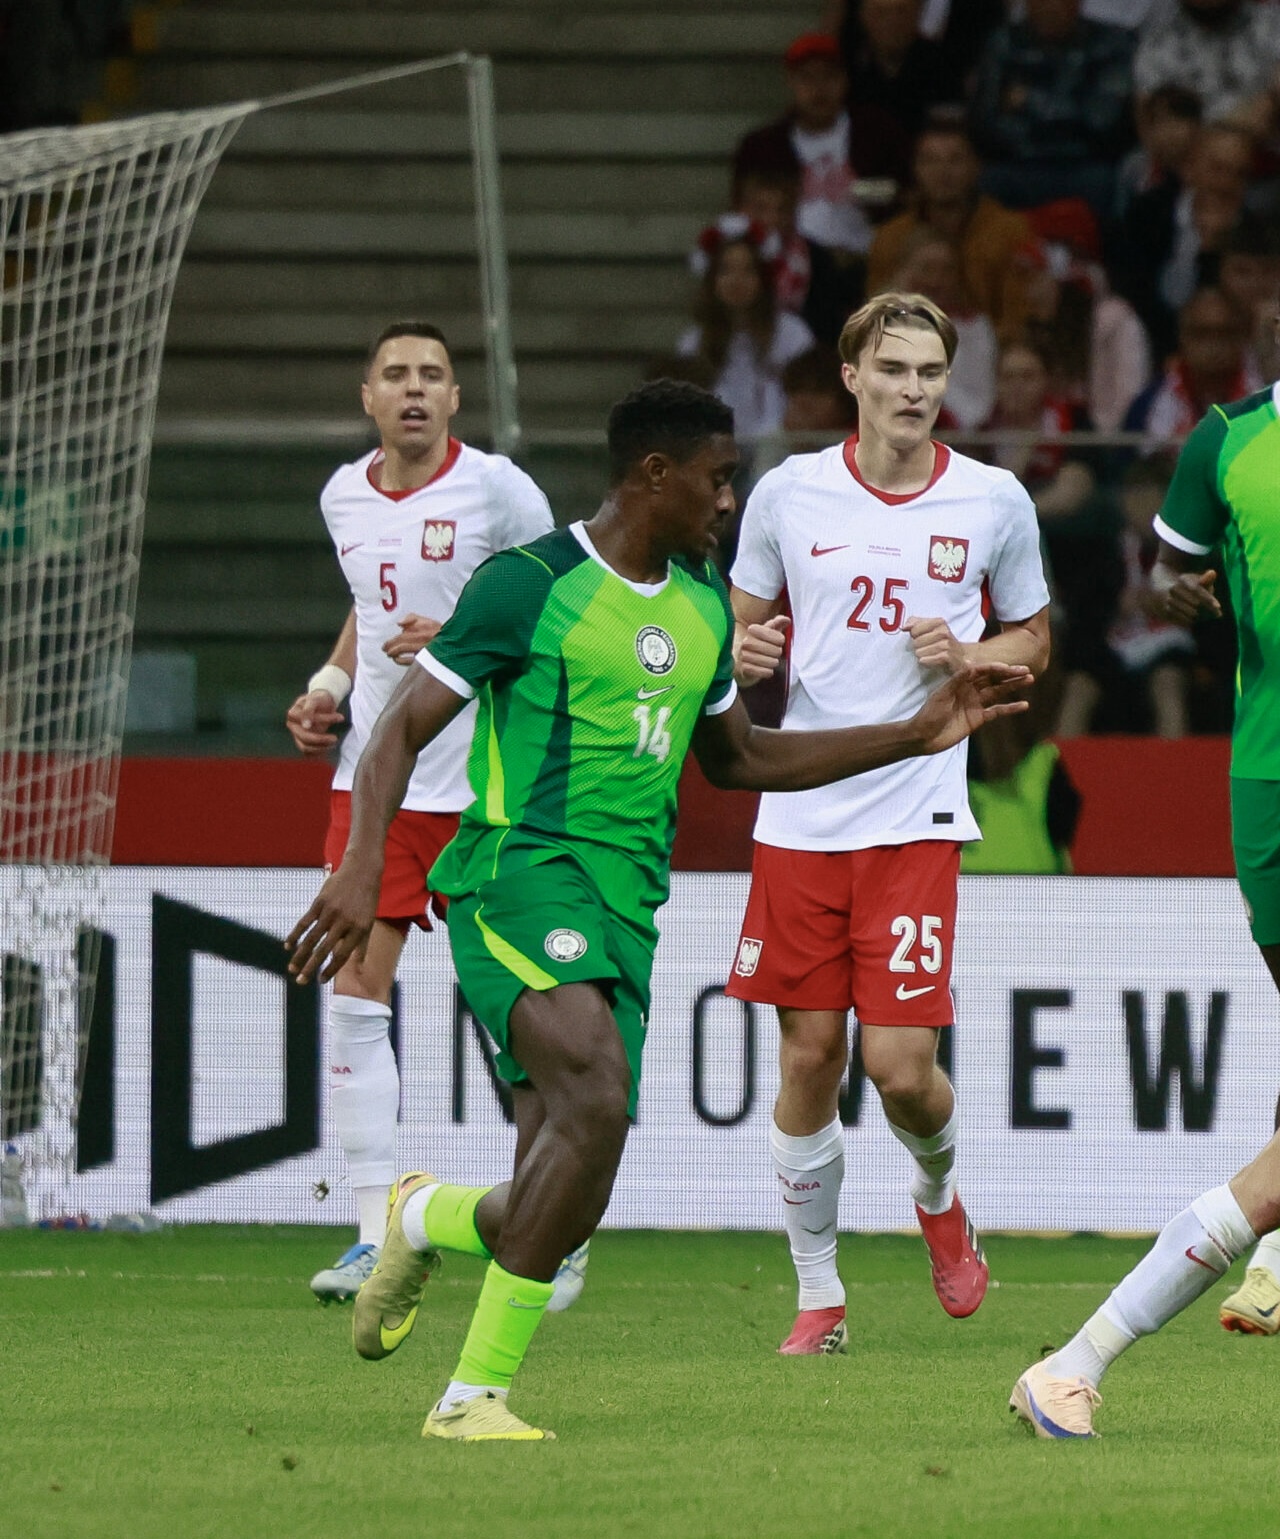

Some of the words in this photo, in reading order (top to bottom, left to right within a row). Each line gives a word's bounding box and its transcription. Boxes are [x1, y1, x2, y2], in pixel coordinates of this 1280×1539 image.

[379, 563, 398, 613] 5
[846, 575, 910, 635] 25
[632, 704, 671, 764] 14
[889, 915, 943, 975] 25
